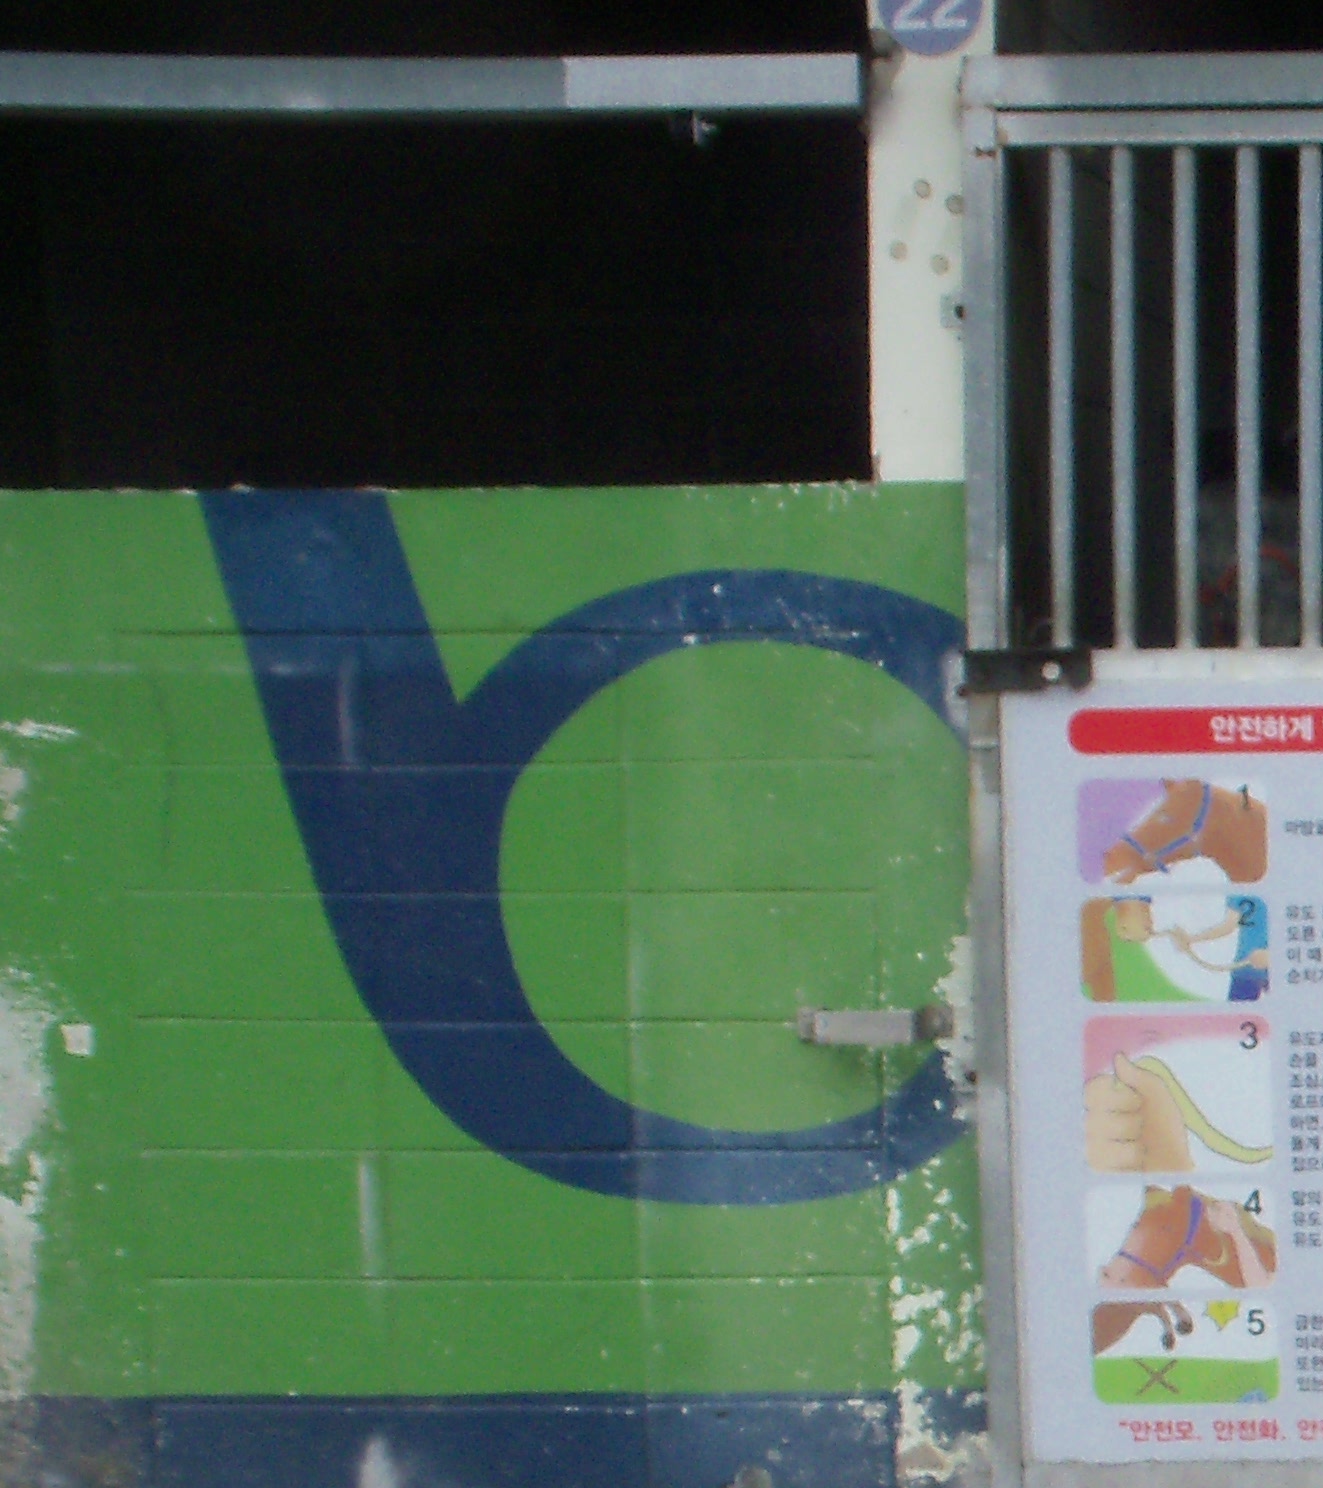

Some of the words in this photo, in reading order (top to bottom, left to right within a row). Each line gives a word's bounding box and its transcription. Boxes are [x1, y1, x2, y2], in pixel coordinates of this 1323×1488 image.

[1211, 714, 1314, 741] 안전하게
[1238, 898, 1255, 926] 2
[1239, 1021, 1257, 1049] 3
[1243, 1189, 1261, 1214] 4
[1247, 1310, 1263, 1335] 5
